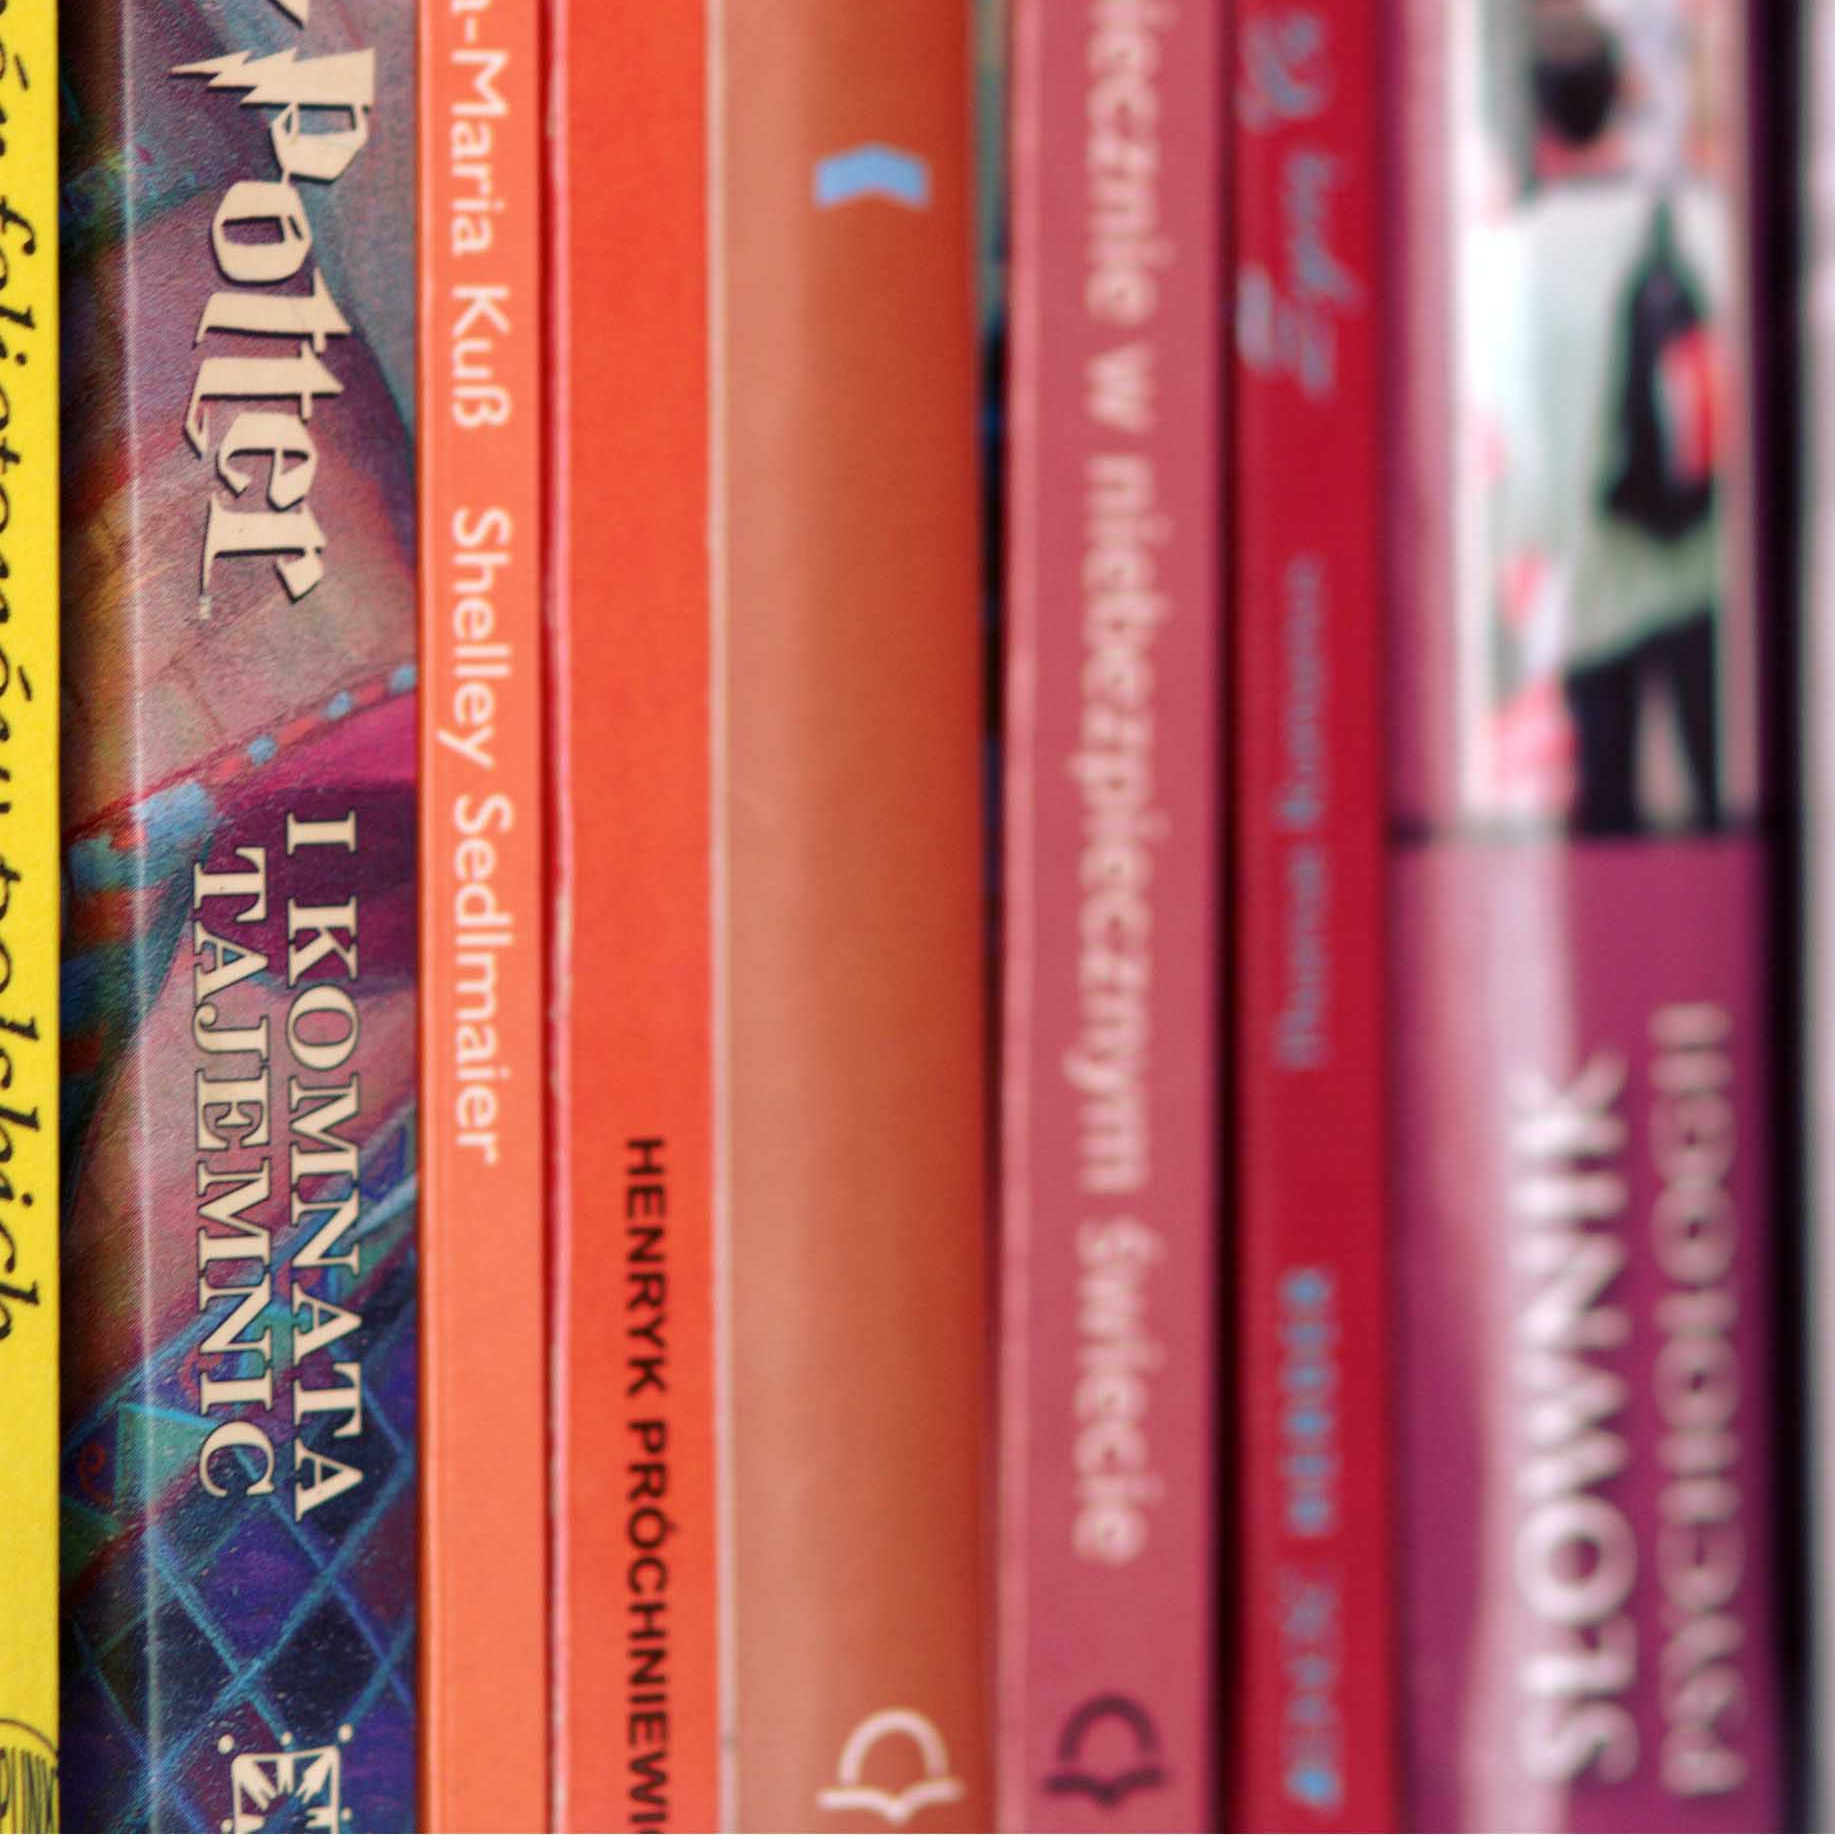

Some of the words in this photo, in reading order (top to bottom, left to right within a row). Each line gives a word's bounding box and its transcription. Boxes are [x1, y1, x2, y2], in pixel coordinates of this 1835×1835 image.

[169, 47, 377, 604] Potter
[449, 285, 513, 430] Kuß
[1086, 343, 1156, 435] w
[436, 506, 514, 768] Shelley
[285, 811, 357, 855] I
[451, 793, 514, 1165] Sedlmaier
[1064, 457, 1172, 1194] niebezpiecznym
[192, 847, 275, 1501] TAJEMNIC
[285, 897, 362, 1522] KOMNATA
[624, 1136, 668, 1398] HENRYK
[1074, 1218, 1166, 1565] świecie
[625, 1419, 679, 1834] PRÓCHNIEWI
